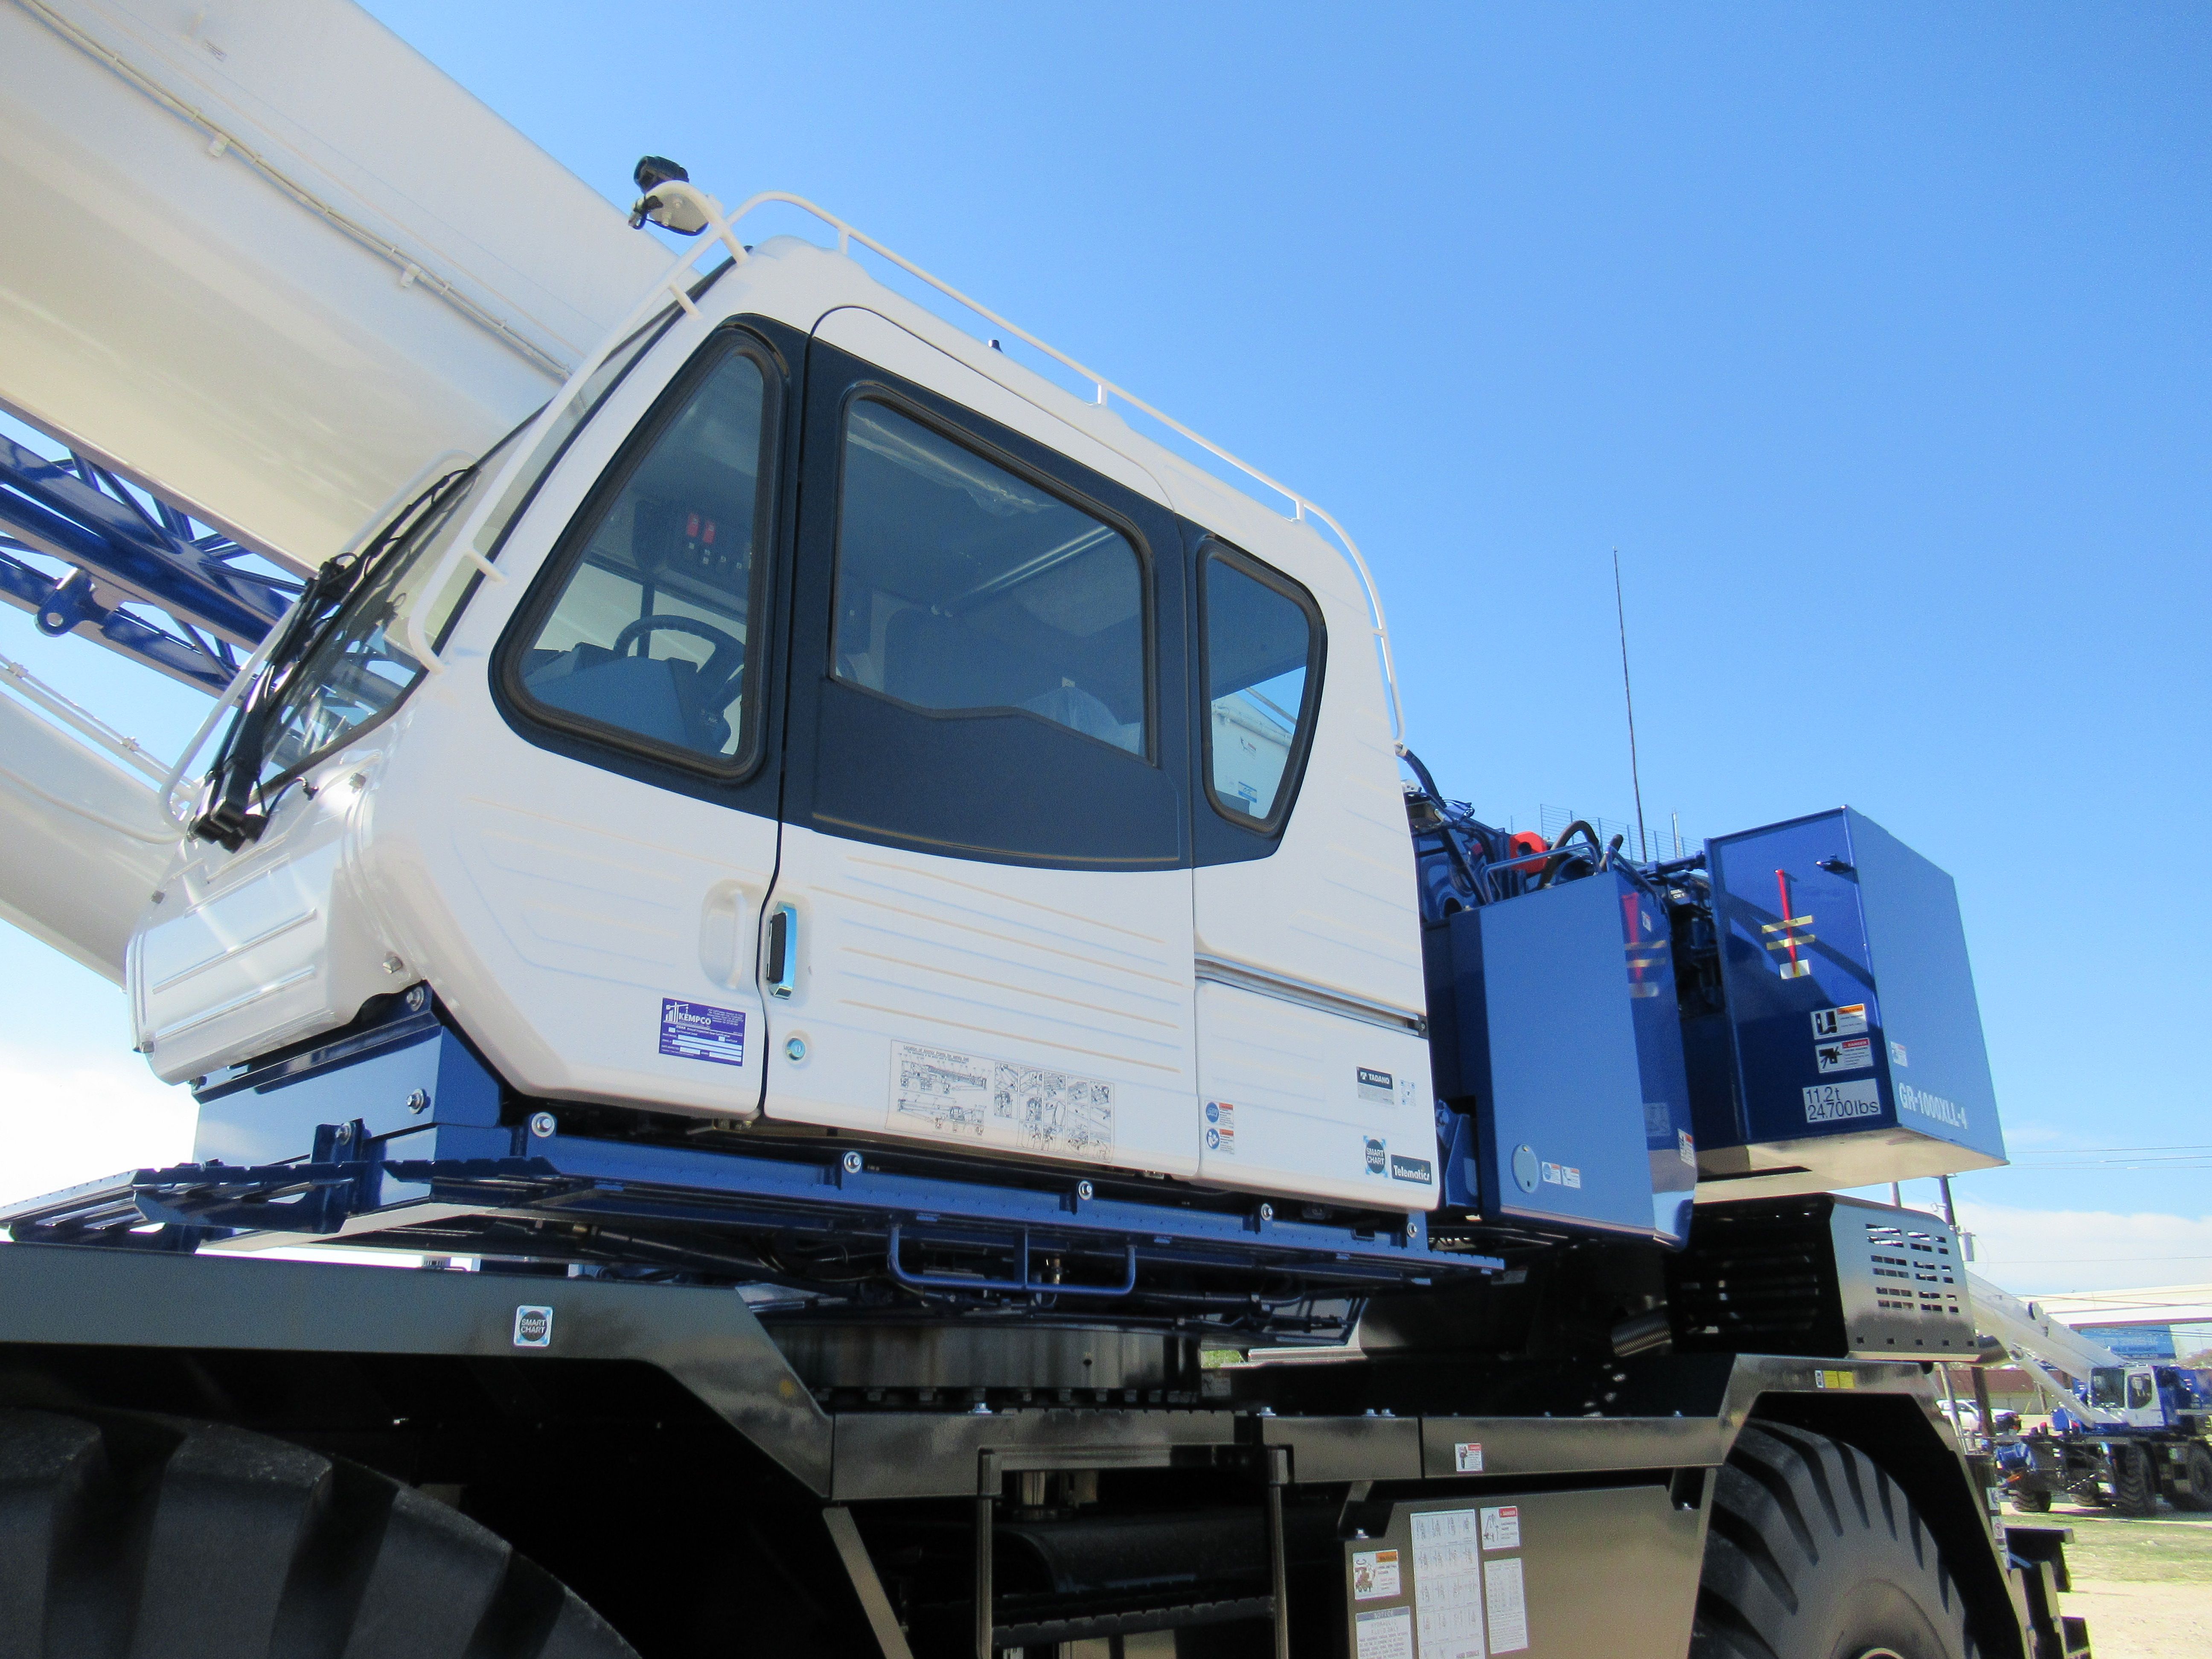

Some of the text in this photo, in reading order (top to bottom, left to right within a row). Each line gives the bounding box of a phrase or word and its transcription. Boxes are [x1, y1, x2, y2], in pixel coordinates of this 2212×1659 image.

[679, 1013, 711, 1025] KEMPCO
[1368, 1073, 1390, 1084] TADANO
[1366, 1147, 1384, 1158] SMART
[1367, 1155, 1385, 1165] CHART
